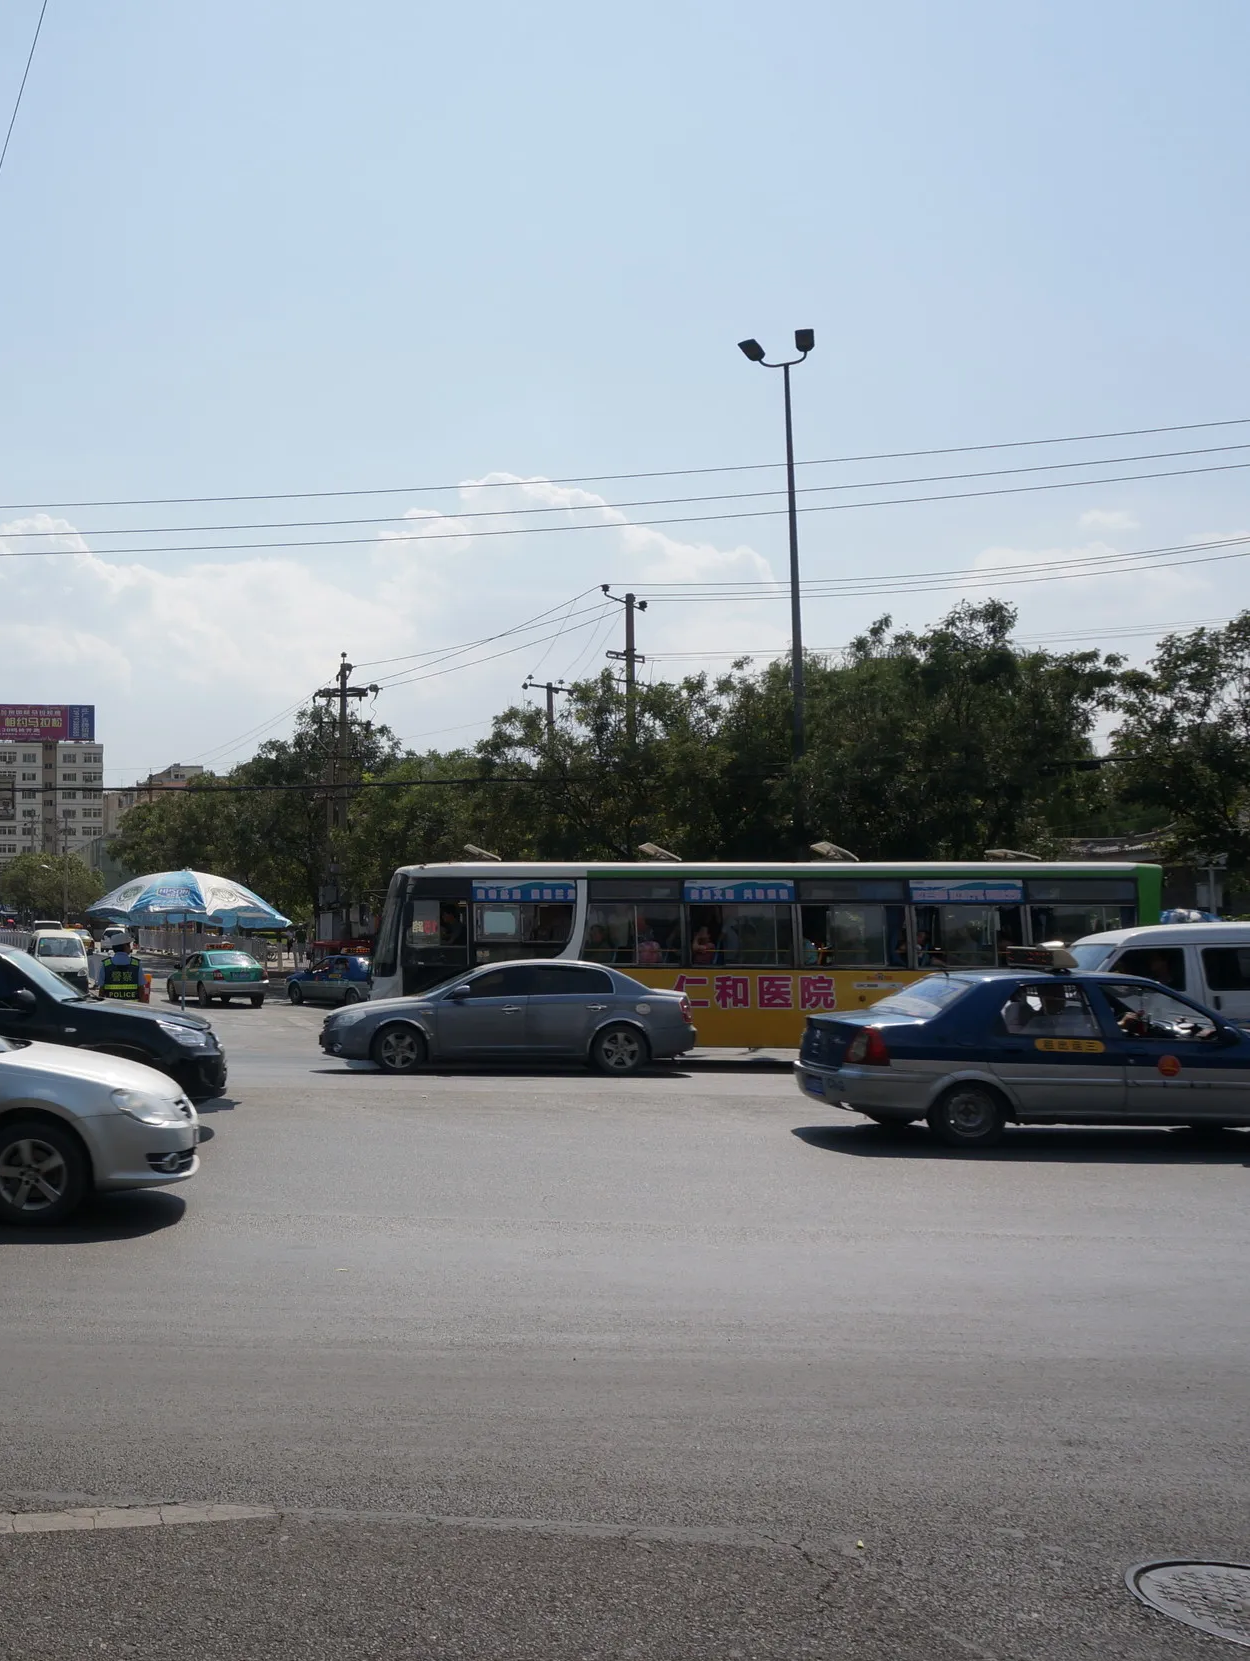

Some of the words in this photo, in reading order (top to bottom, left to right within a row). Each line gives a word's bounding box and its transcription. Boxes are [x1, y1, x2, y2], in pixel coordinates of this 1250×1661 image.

[111, 971, 133, 981] 警察
[674, 974, 837, 1010] 仁和医院
